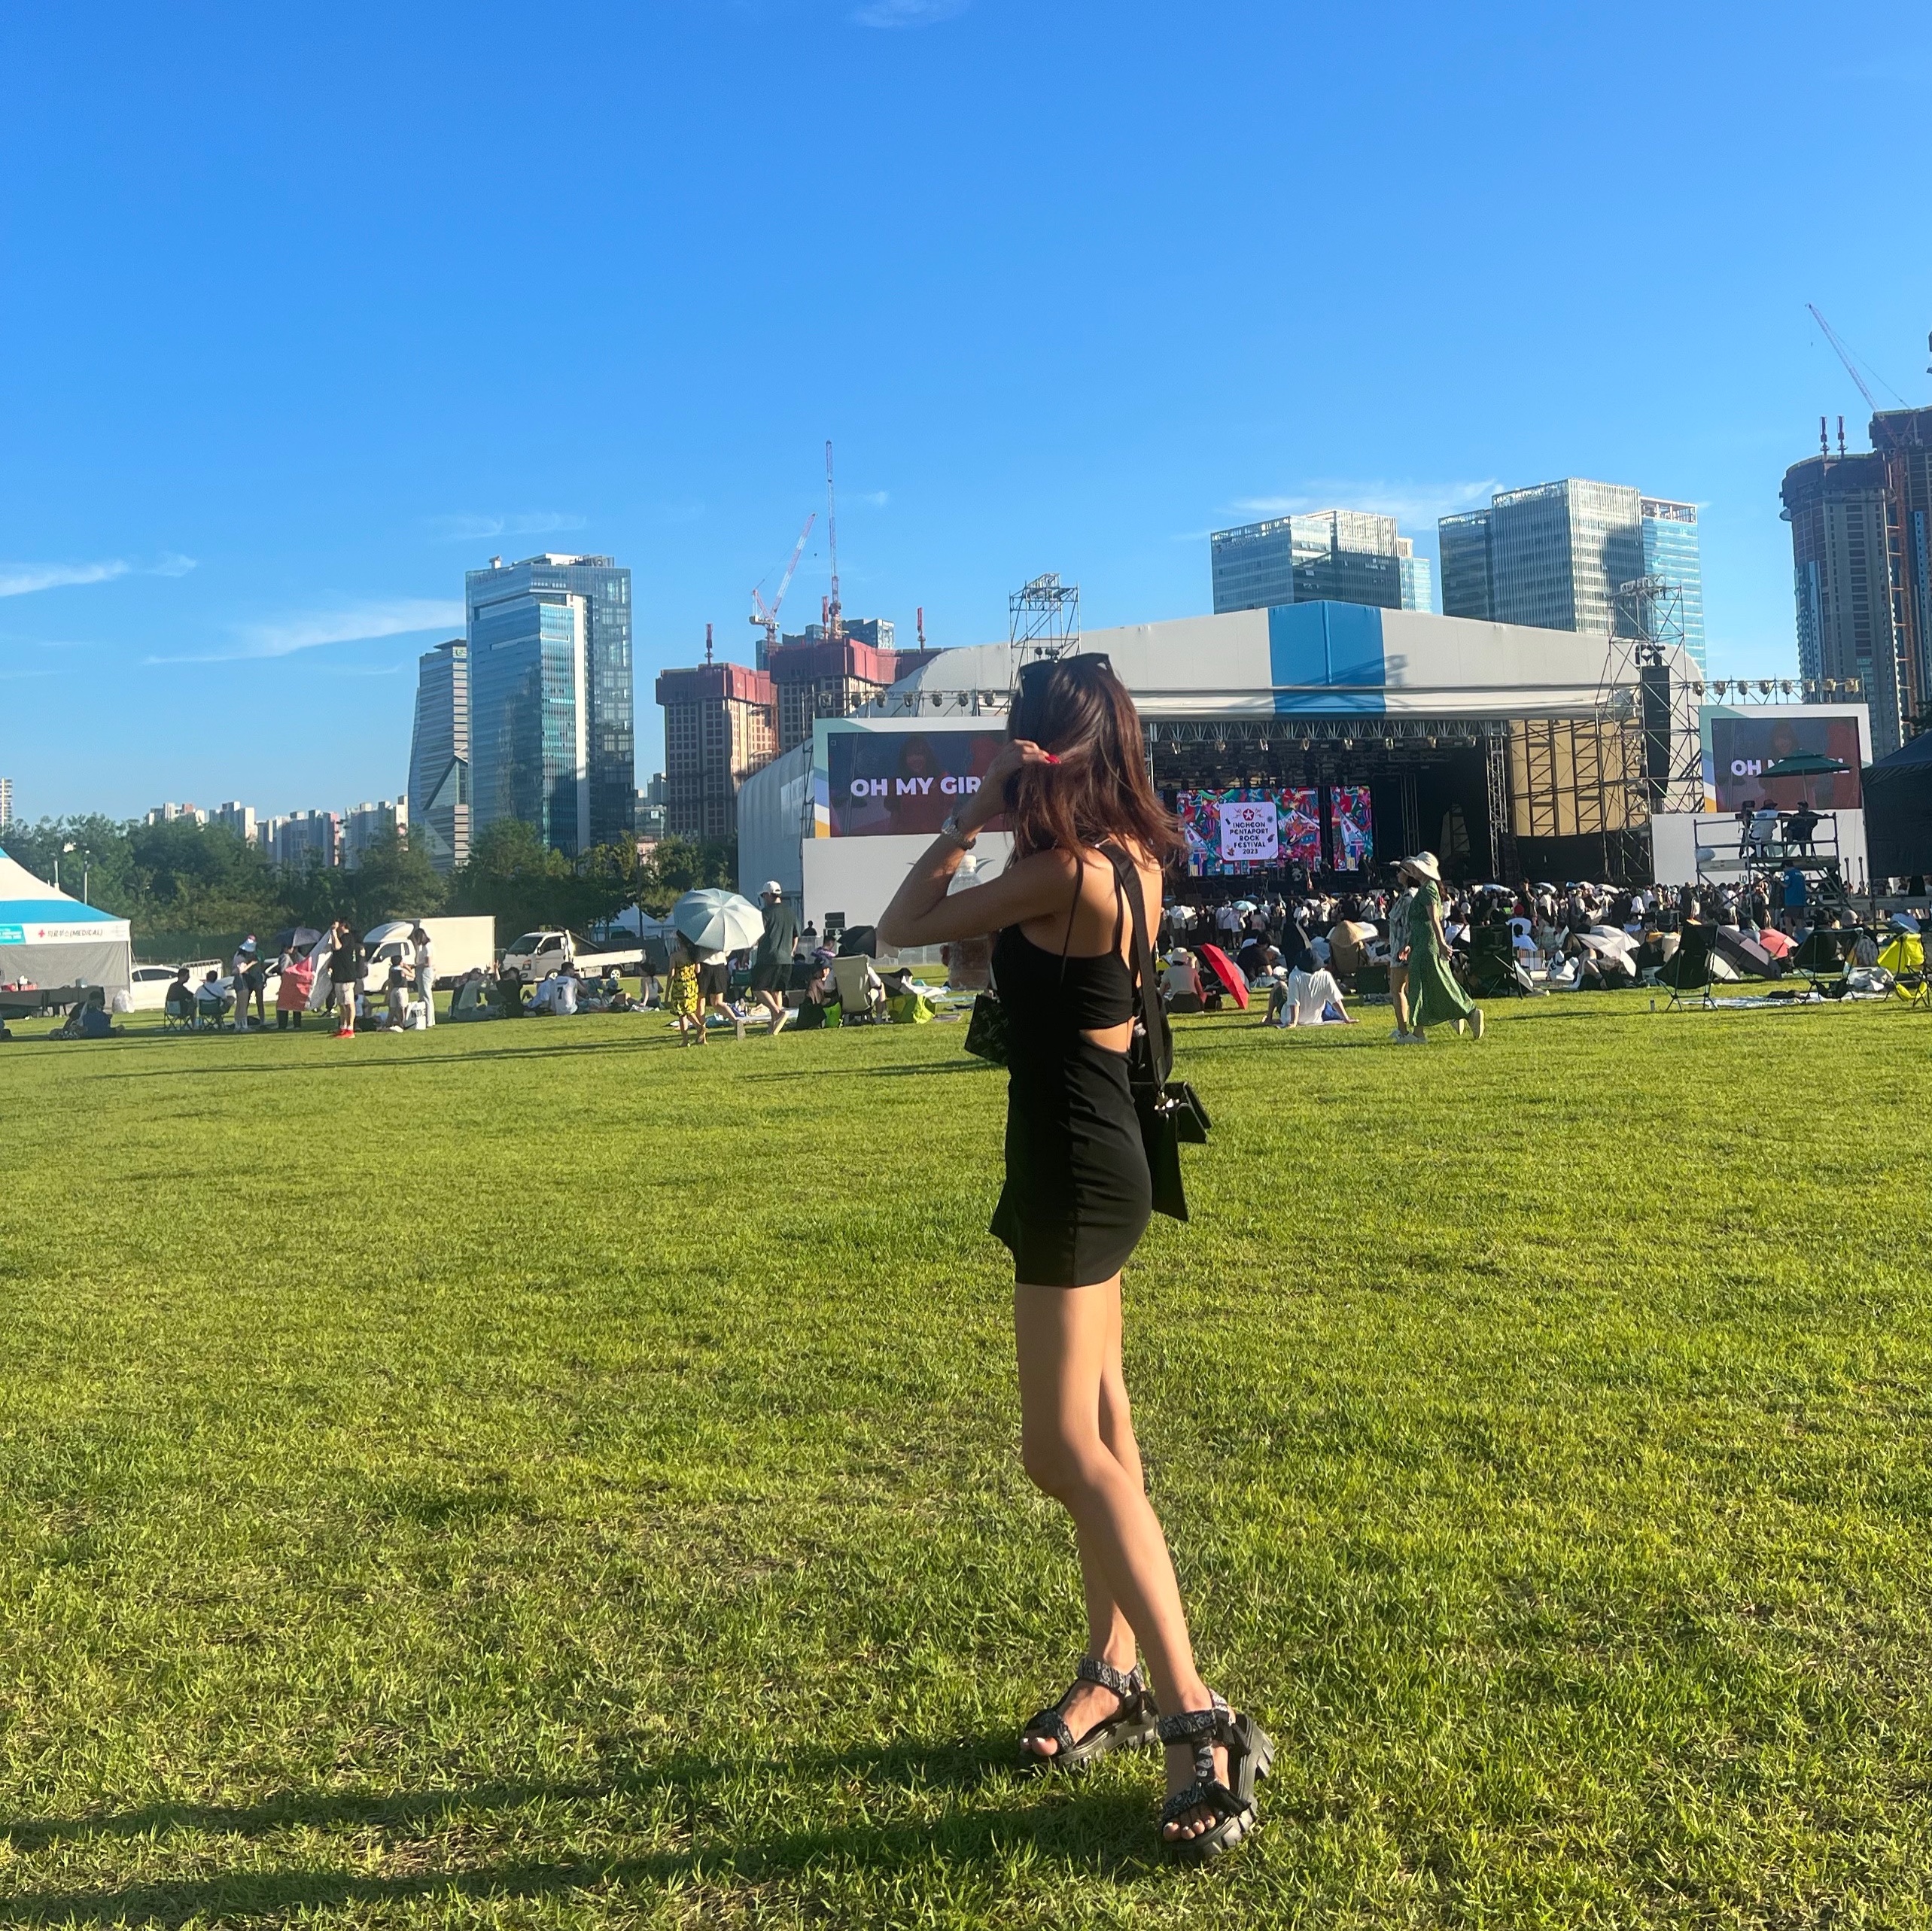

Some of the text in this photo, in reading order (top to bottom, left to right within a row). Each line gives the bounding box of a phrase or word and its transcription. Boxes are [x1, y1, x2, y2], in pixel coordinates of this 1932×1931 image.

[1731, 759, 1762, 776] OH
[850, 776, 984, 797] OH MY GIR
[558, 987, 563, 999] 7
